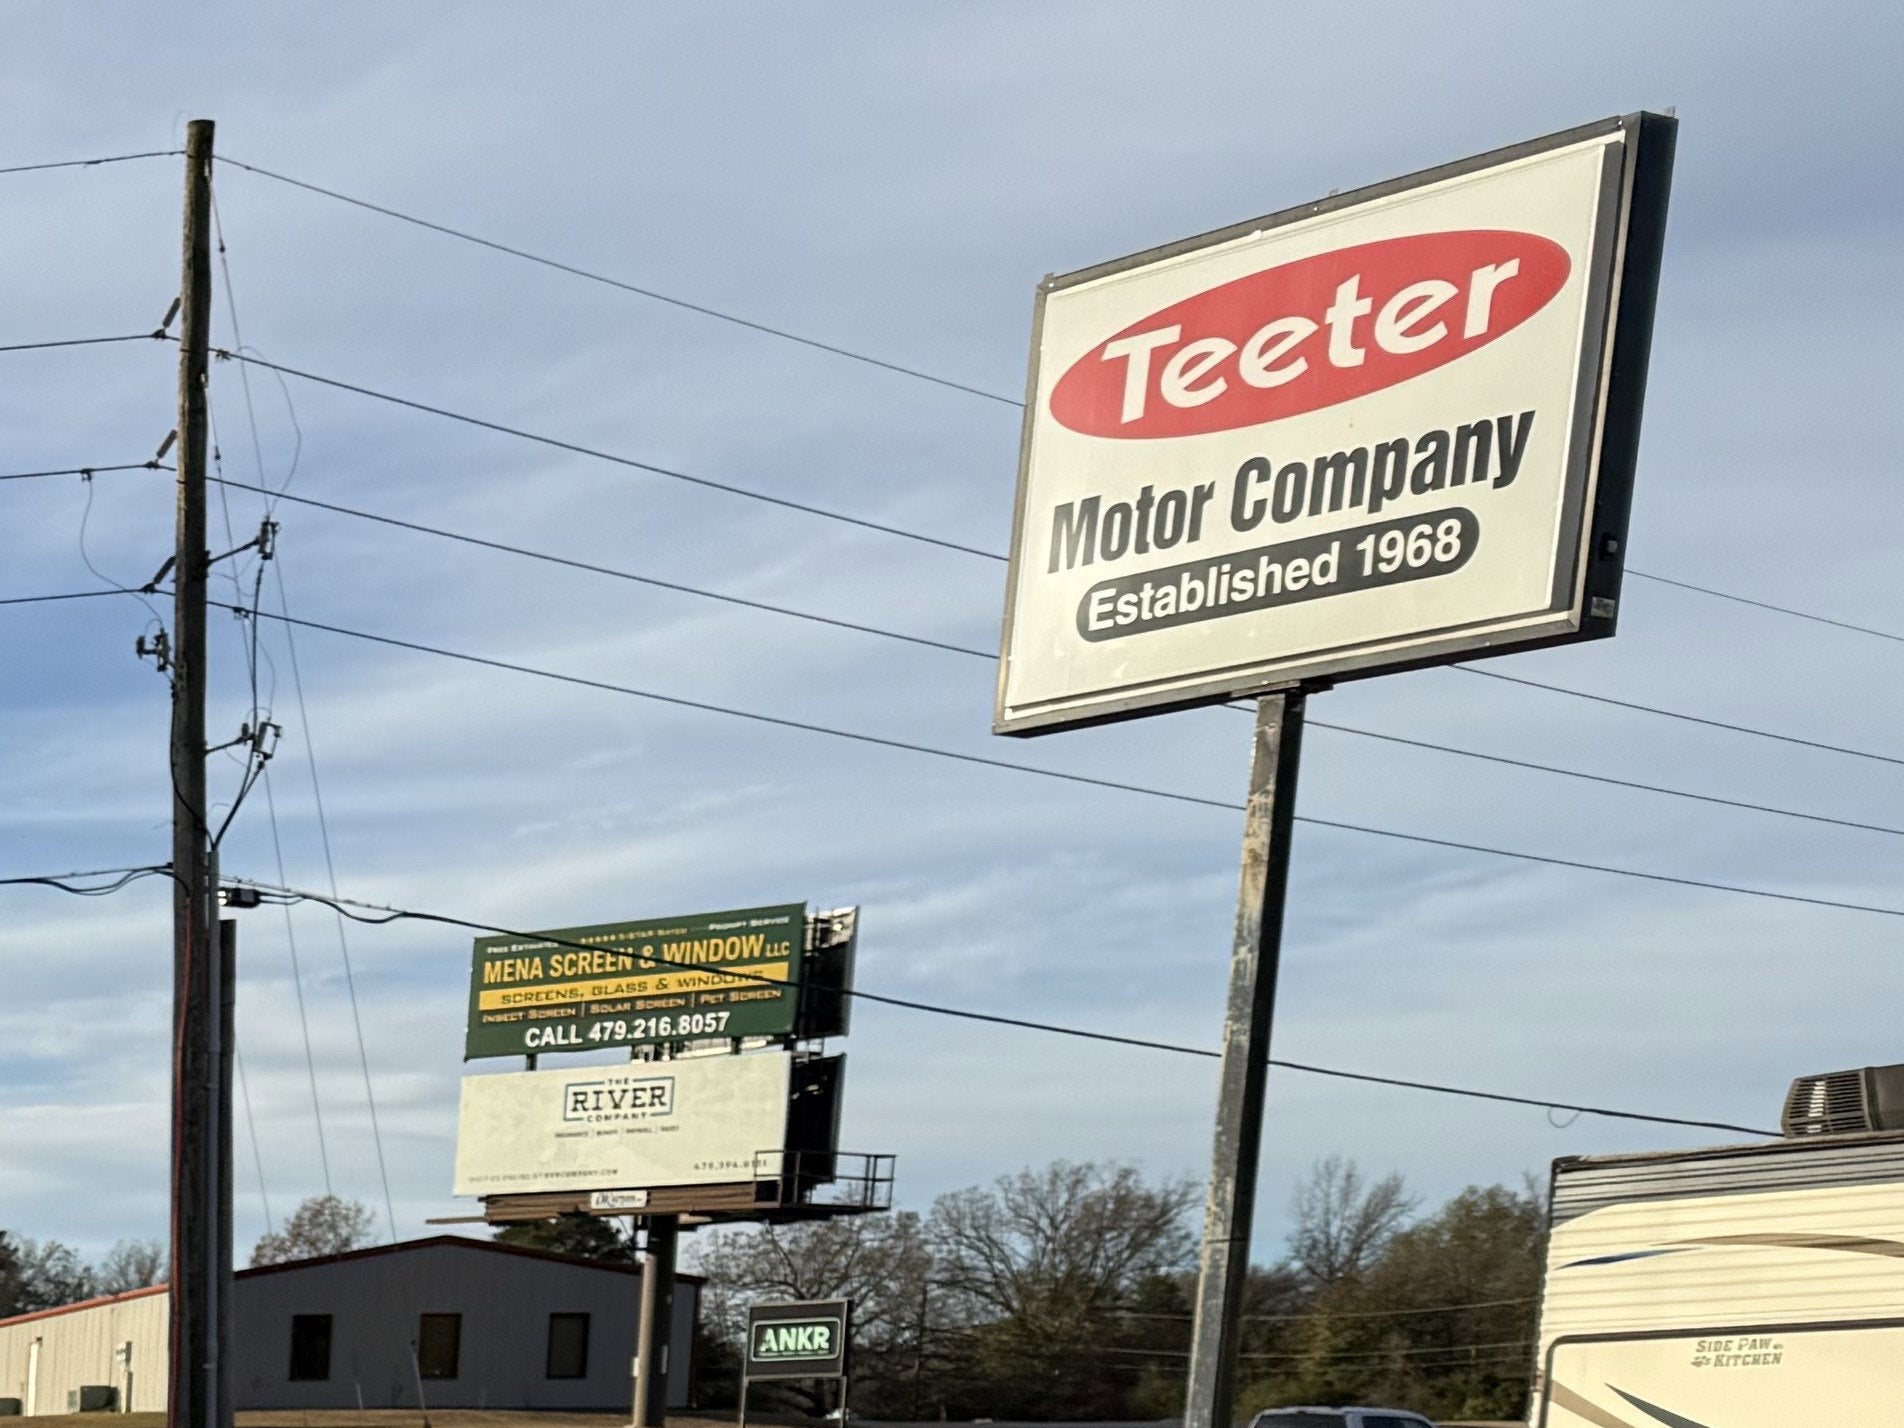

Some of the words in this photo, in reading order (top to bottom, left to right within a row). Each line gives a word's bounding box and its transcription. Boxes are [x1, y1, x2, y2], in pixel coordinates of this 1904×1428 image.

[1101, 257, 1518, 425] Teeter
[1047, 480, 1216, 575] Motor
[1231, 410, 1535, 532] Company
[1088, 543, 1339, 632] Established
[1356, 517, 1462, 578] 1968
[483, 957, 544, 984] MENA
[549, 946, 634, 978] SCREEN
[662, 933, 766, 965] WINDOW
[765, 941, 791, 958] LLC
[501, 988, 584, 1005] SCREENS,
[592, 981, 649, 997] GLASS
[655, 977, 670, 991] &
[524, 1023, 583, 1047] CALL
[588, 1011, 730, 1043] 479.216.8057
[571, 1085, 667, 1112] RIVER
[586, 1111, 647, 1123] COMPANY
[760, 1326, 830, 1352] ANKR
[1714, 1352, 1783, 1368] KITCHEN
